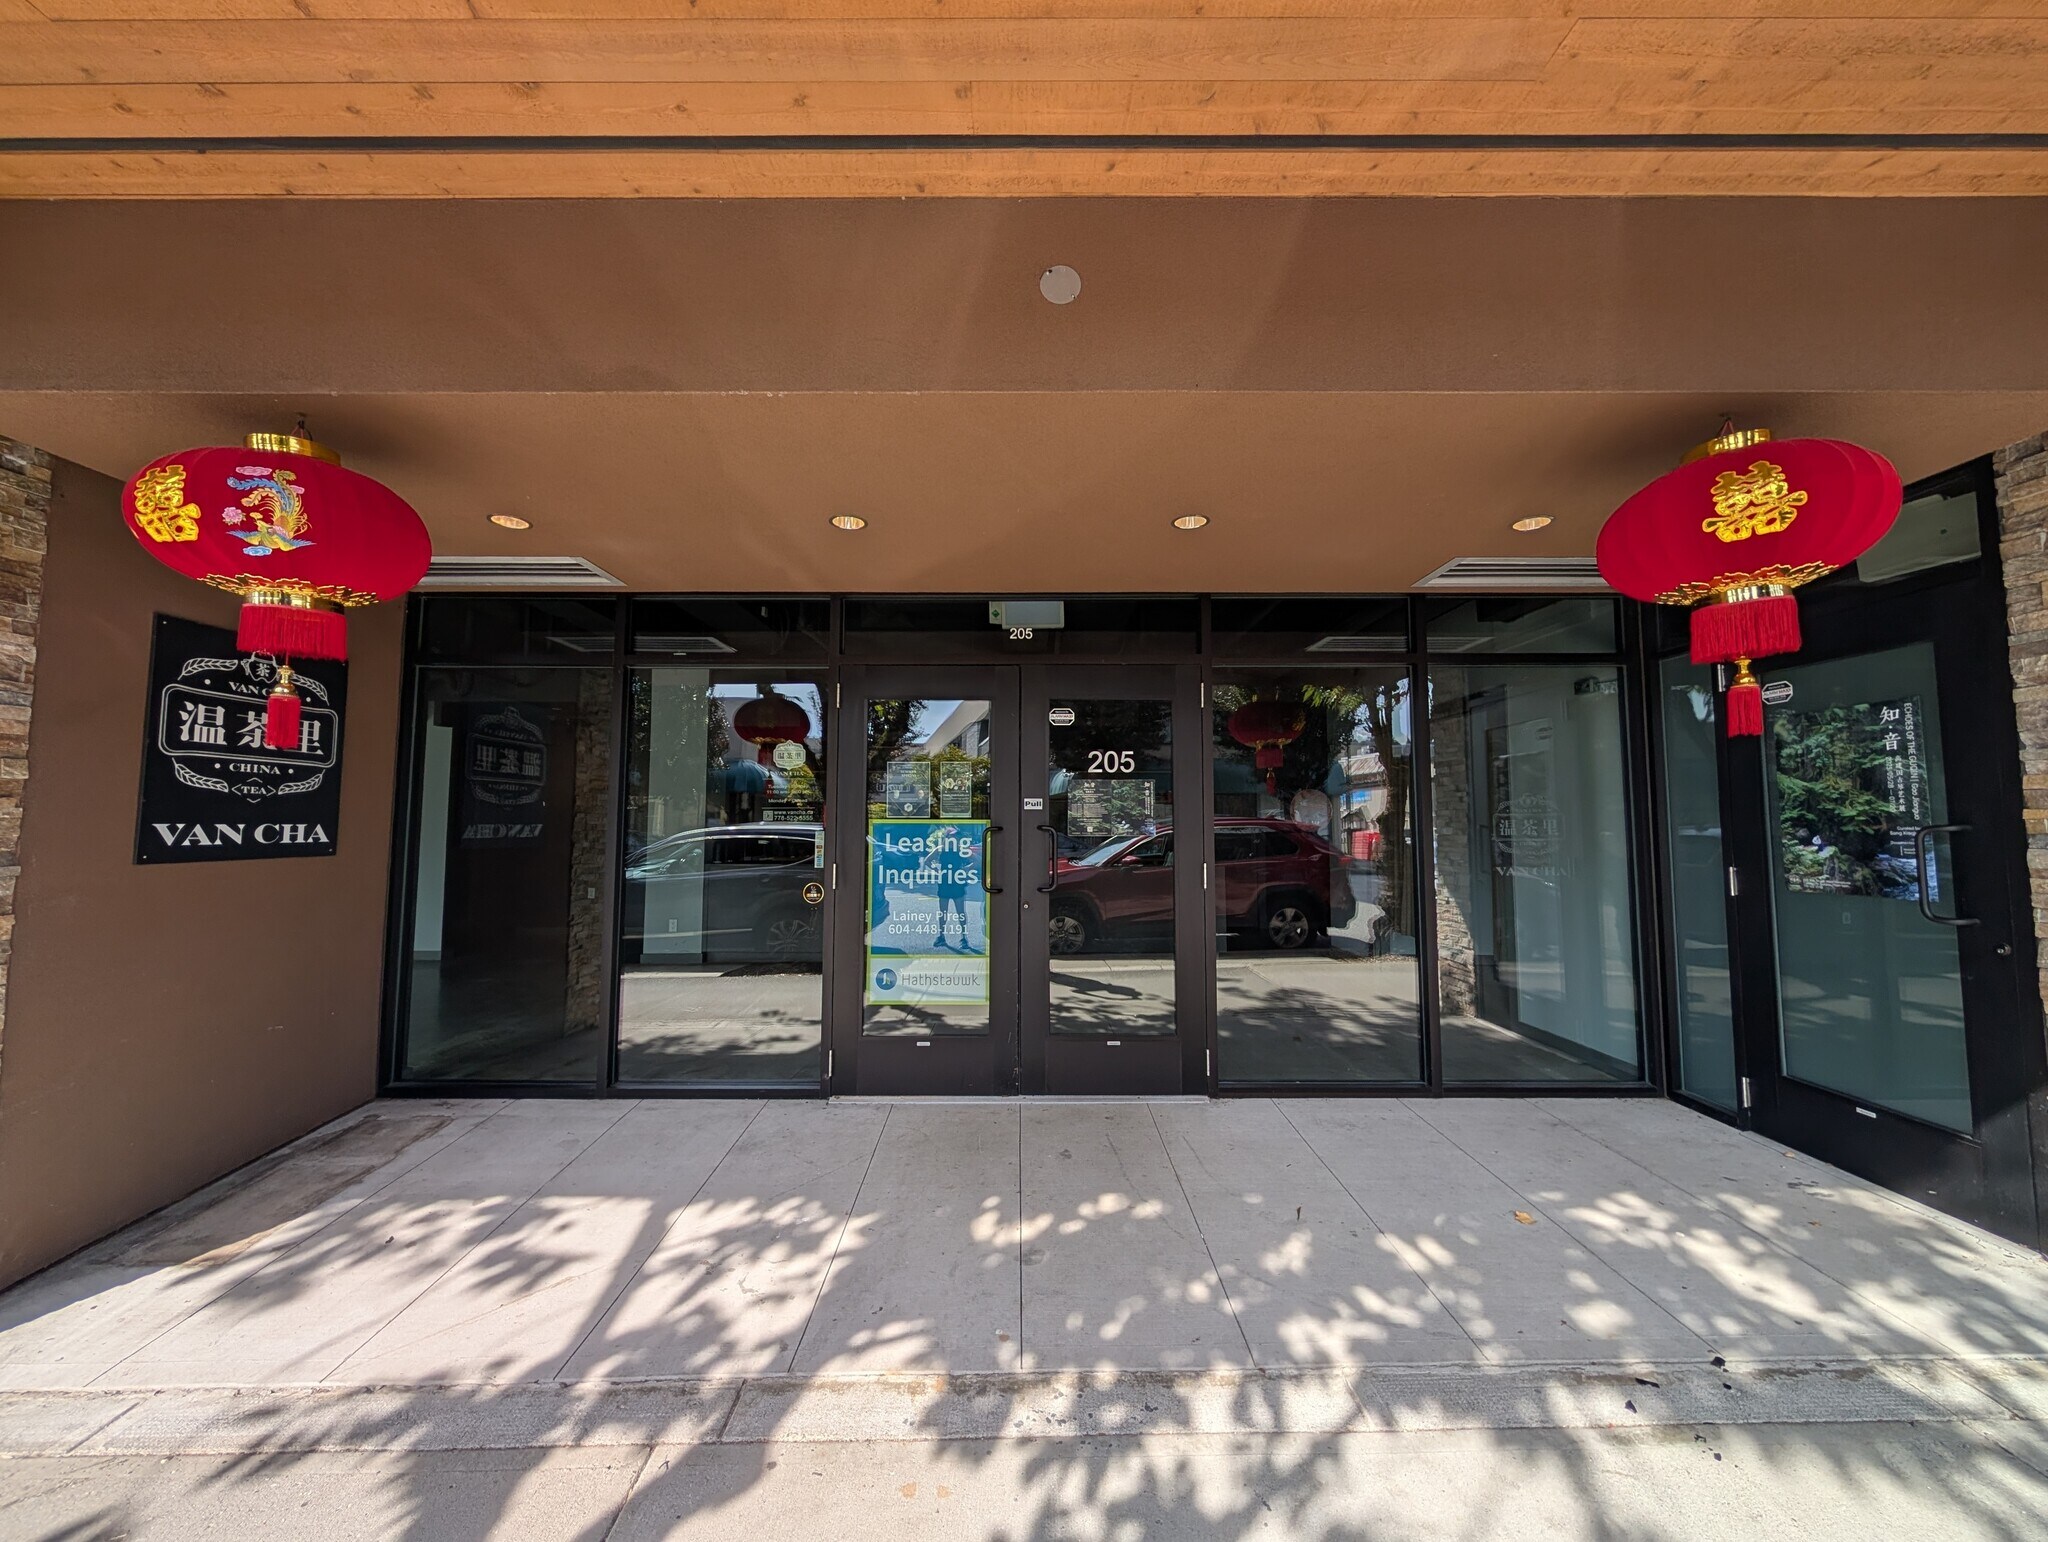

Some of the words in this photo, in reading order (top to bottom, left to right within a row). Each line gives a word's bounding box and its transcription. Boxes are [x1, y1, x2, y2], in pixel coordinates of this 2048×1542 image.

[1009, 627, 1033, 640] 205
[256, 662, 271, 678] 茶
[228, 681, 260, 696] VAN
[1903, 702, 1914, 731] ECHOES
[1905, 730, 1915, 741] OF
[1907, 741, 1917, 755] THE
[229, 762, 281, 775] CHINA
[1087, 750, 1136, 773] 205
[240, 784, 268, 796] TEA
[1024, 800, 1042, 808] Pull
[152, 823, 247, 847] VAN
[253, 822, 330, 844] CHA
[885, 833, 973, 858] Leasing
[878, 863, 979, 889] Inquiries
[893, 910, 932, 925] Lainey
[935, 910, 966, 922] Pires
[888, 924, 969, 935] 604-448-1191
[901, 973, 981, 986] Hathstauwk
